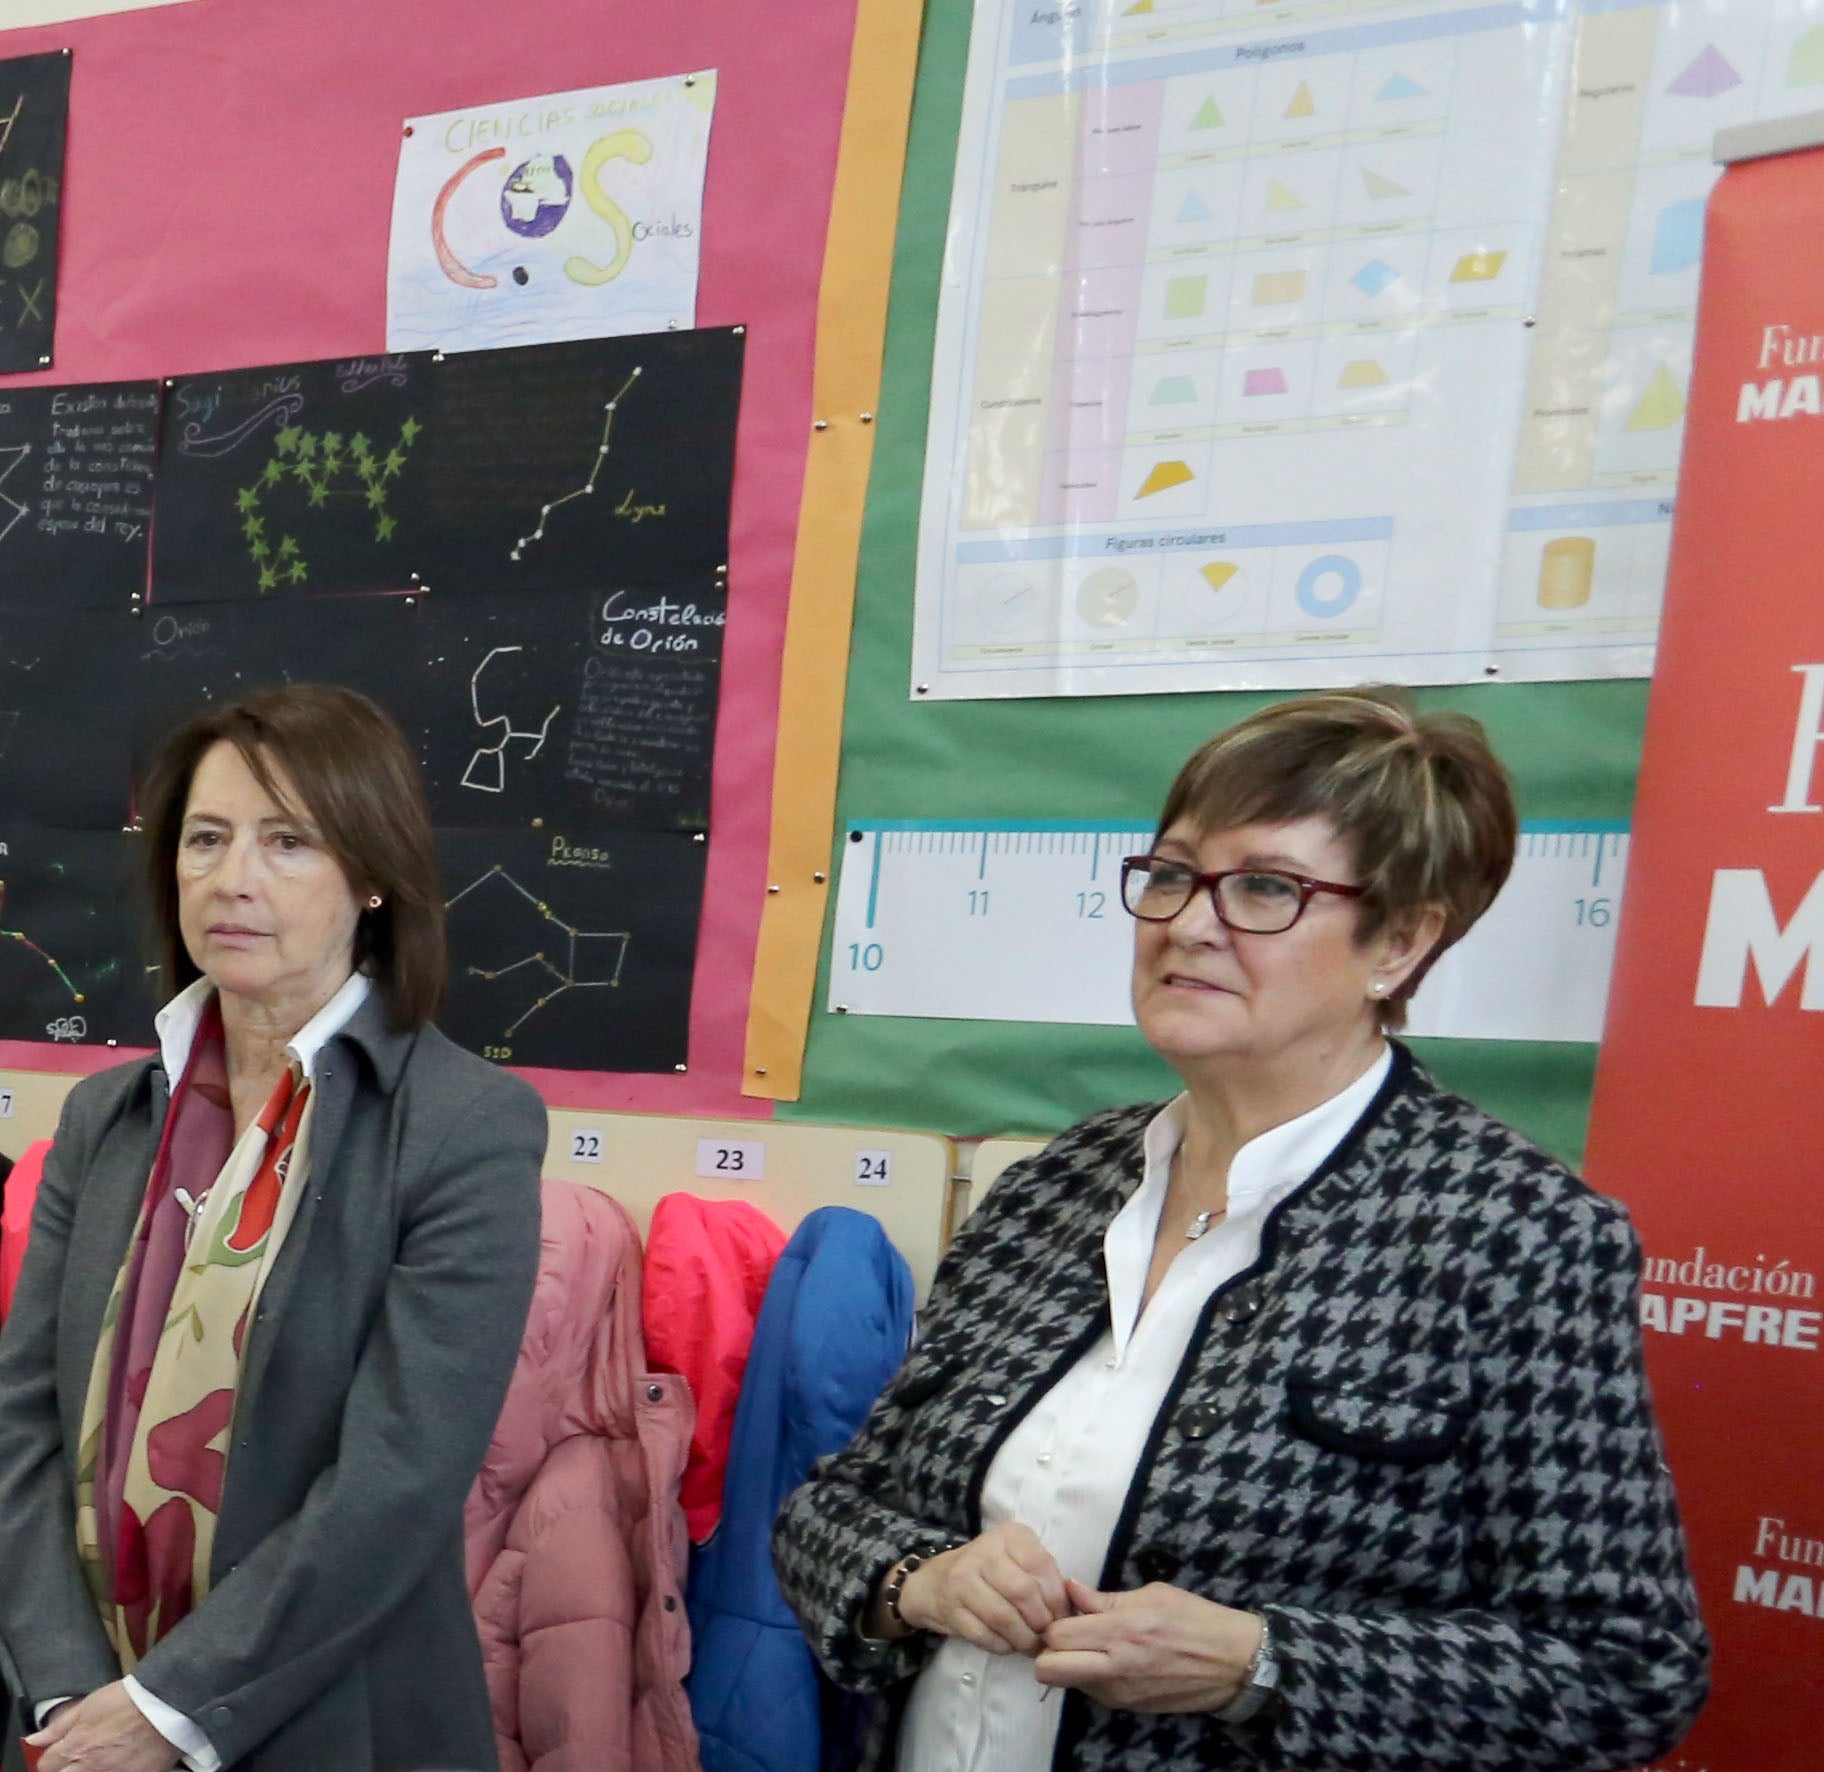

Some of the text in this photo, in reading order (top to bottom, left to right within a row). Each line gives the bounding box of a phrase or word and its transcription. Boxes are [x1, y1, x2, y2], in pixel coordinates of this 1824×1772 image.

[1105, 535, 1154, 553] Figuras
[967, 891, 989, 917] 11
[1077, 892, 1107, 920] 12
[1574, 898, 1611, 928] 16
[848, 942, 884, 972] 10
[573, 1135, 600, 1157] 22
[715, 1149, 745, 1171] 23
[858, 1158, 888, 1181] 24
[1639, 1293, 1824, 1351] APFRE
